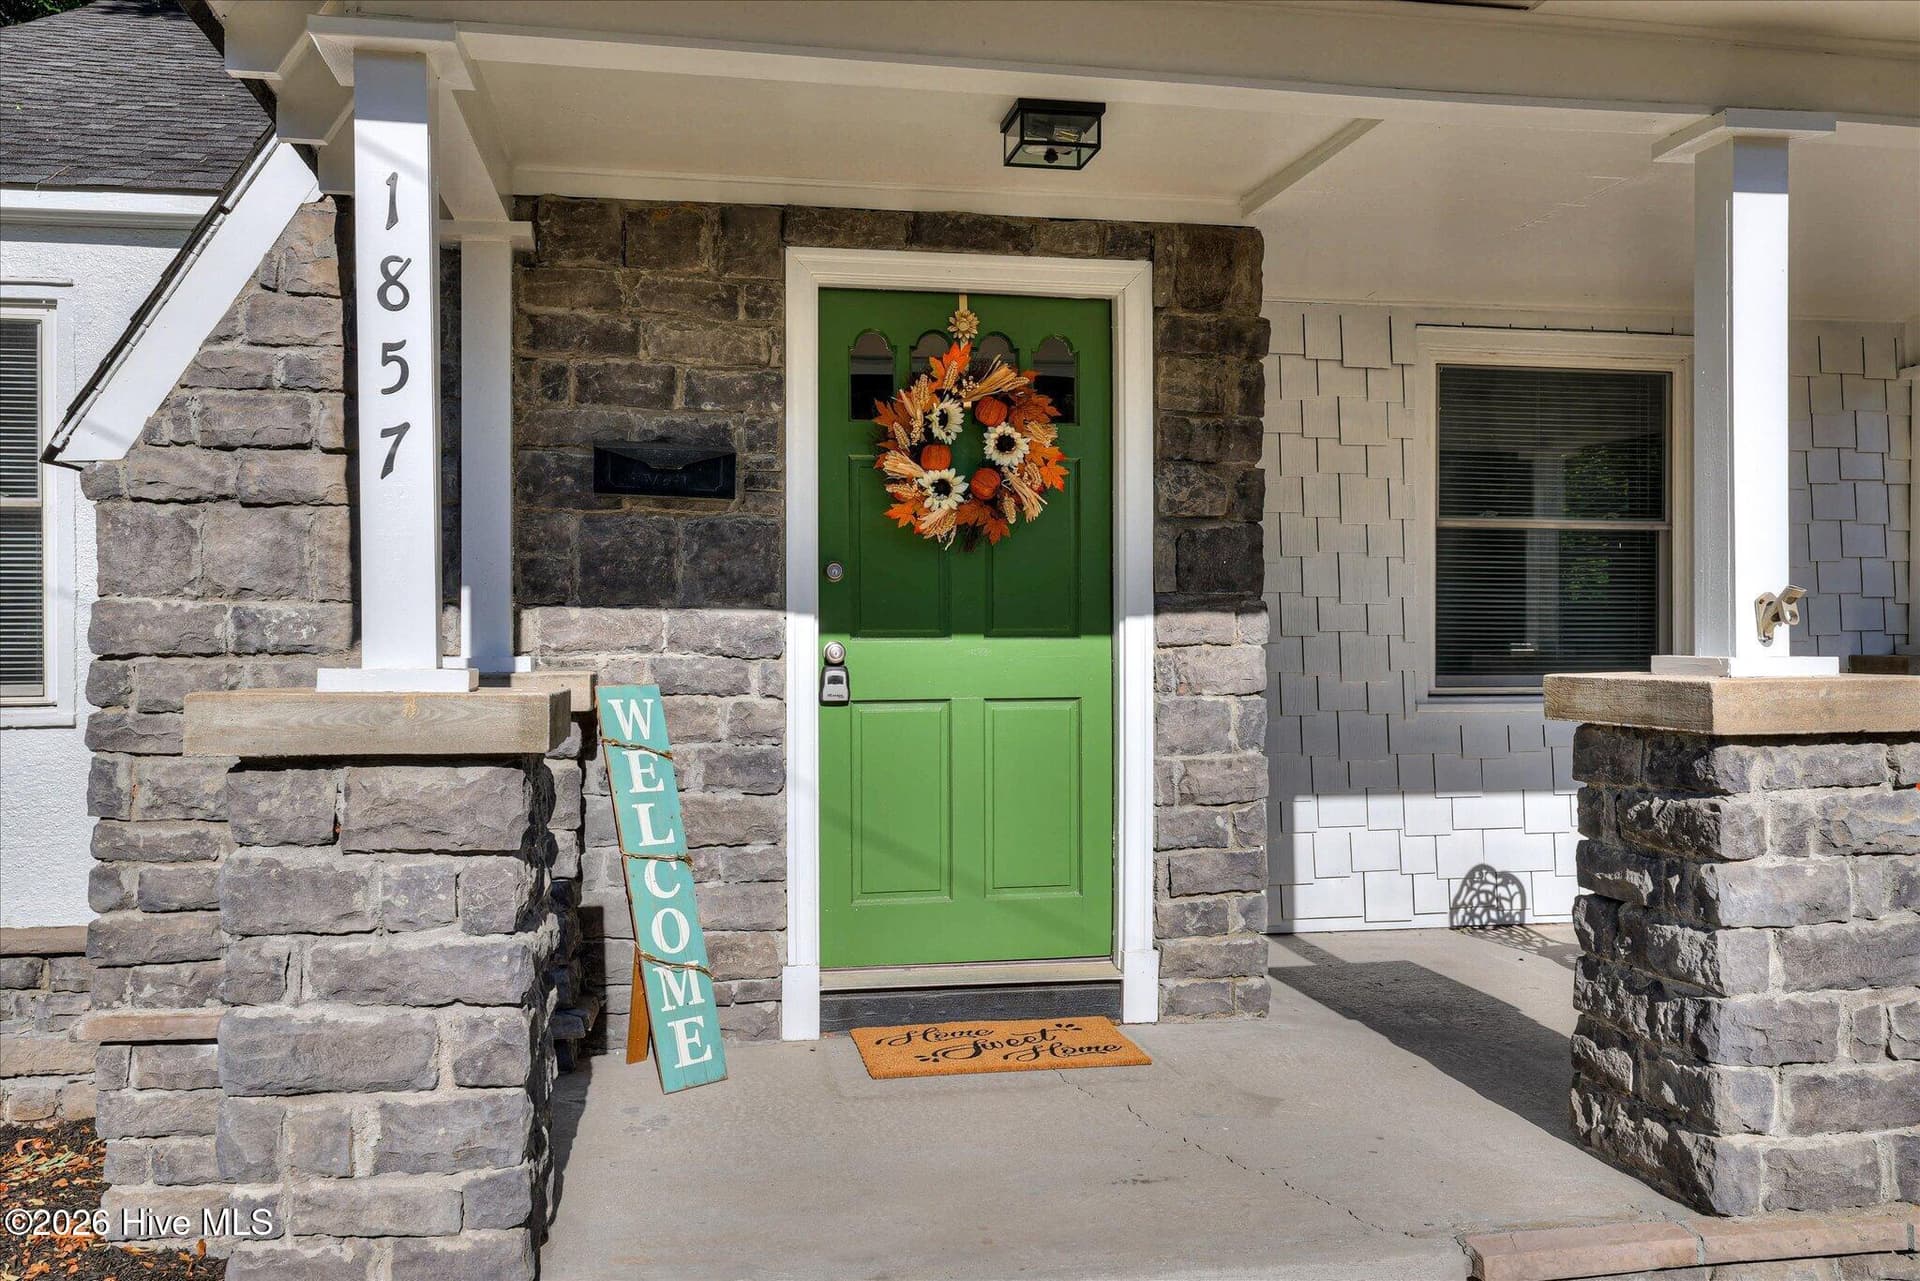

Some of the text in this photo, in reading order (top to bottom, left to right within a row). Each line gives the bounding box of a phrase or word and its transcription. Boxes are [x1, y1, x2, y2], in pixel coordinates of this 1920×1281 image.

[376, 171, 412, 480] 1857
[608, 698, 712, 1069] WELCOME
[875, 1027, 994, 1046] Home
[932, 1023, 1057, 1060] Sweet
[1003, 1041, 1123, 1062] Home
